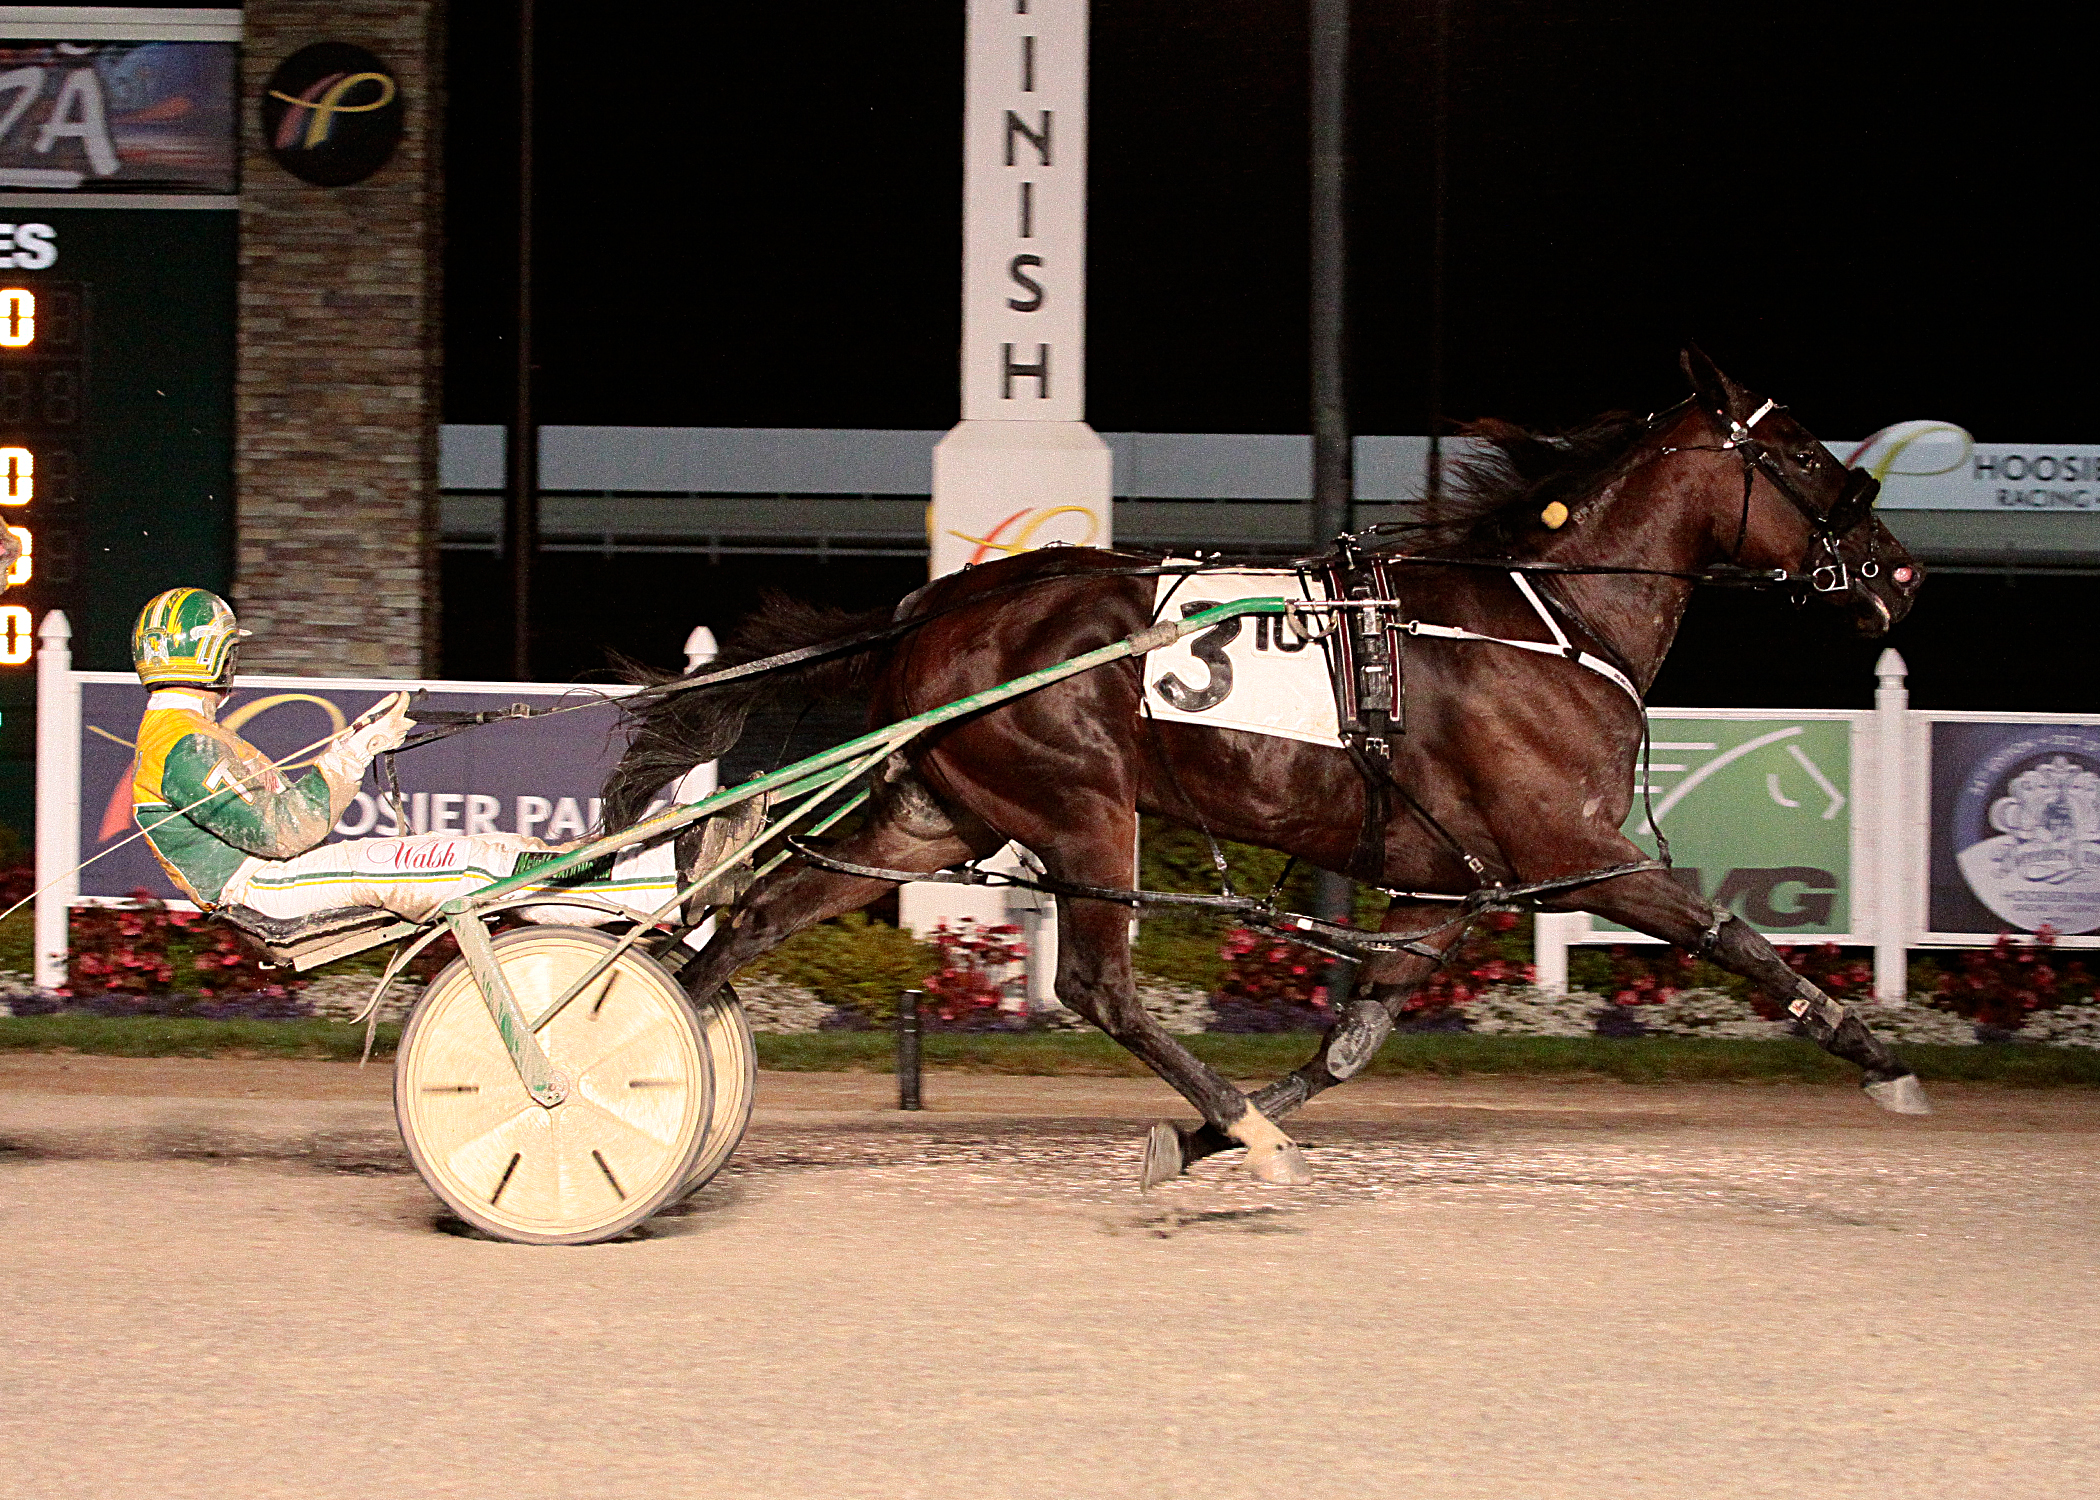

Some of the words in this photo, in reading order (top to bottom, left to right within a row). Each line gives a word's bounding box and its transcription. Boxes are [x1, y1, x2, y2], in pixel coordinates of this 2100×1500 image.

[1001, 0, 1053, 400] INISH
[1973, 454, 2100, 482] HOOSI
[1153, 600, 1242, 712] 3
[366, 840, 458, 870] Walsh
